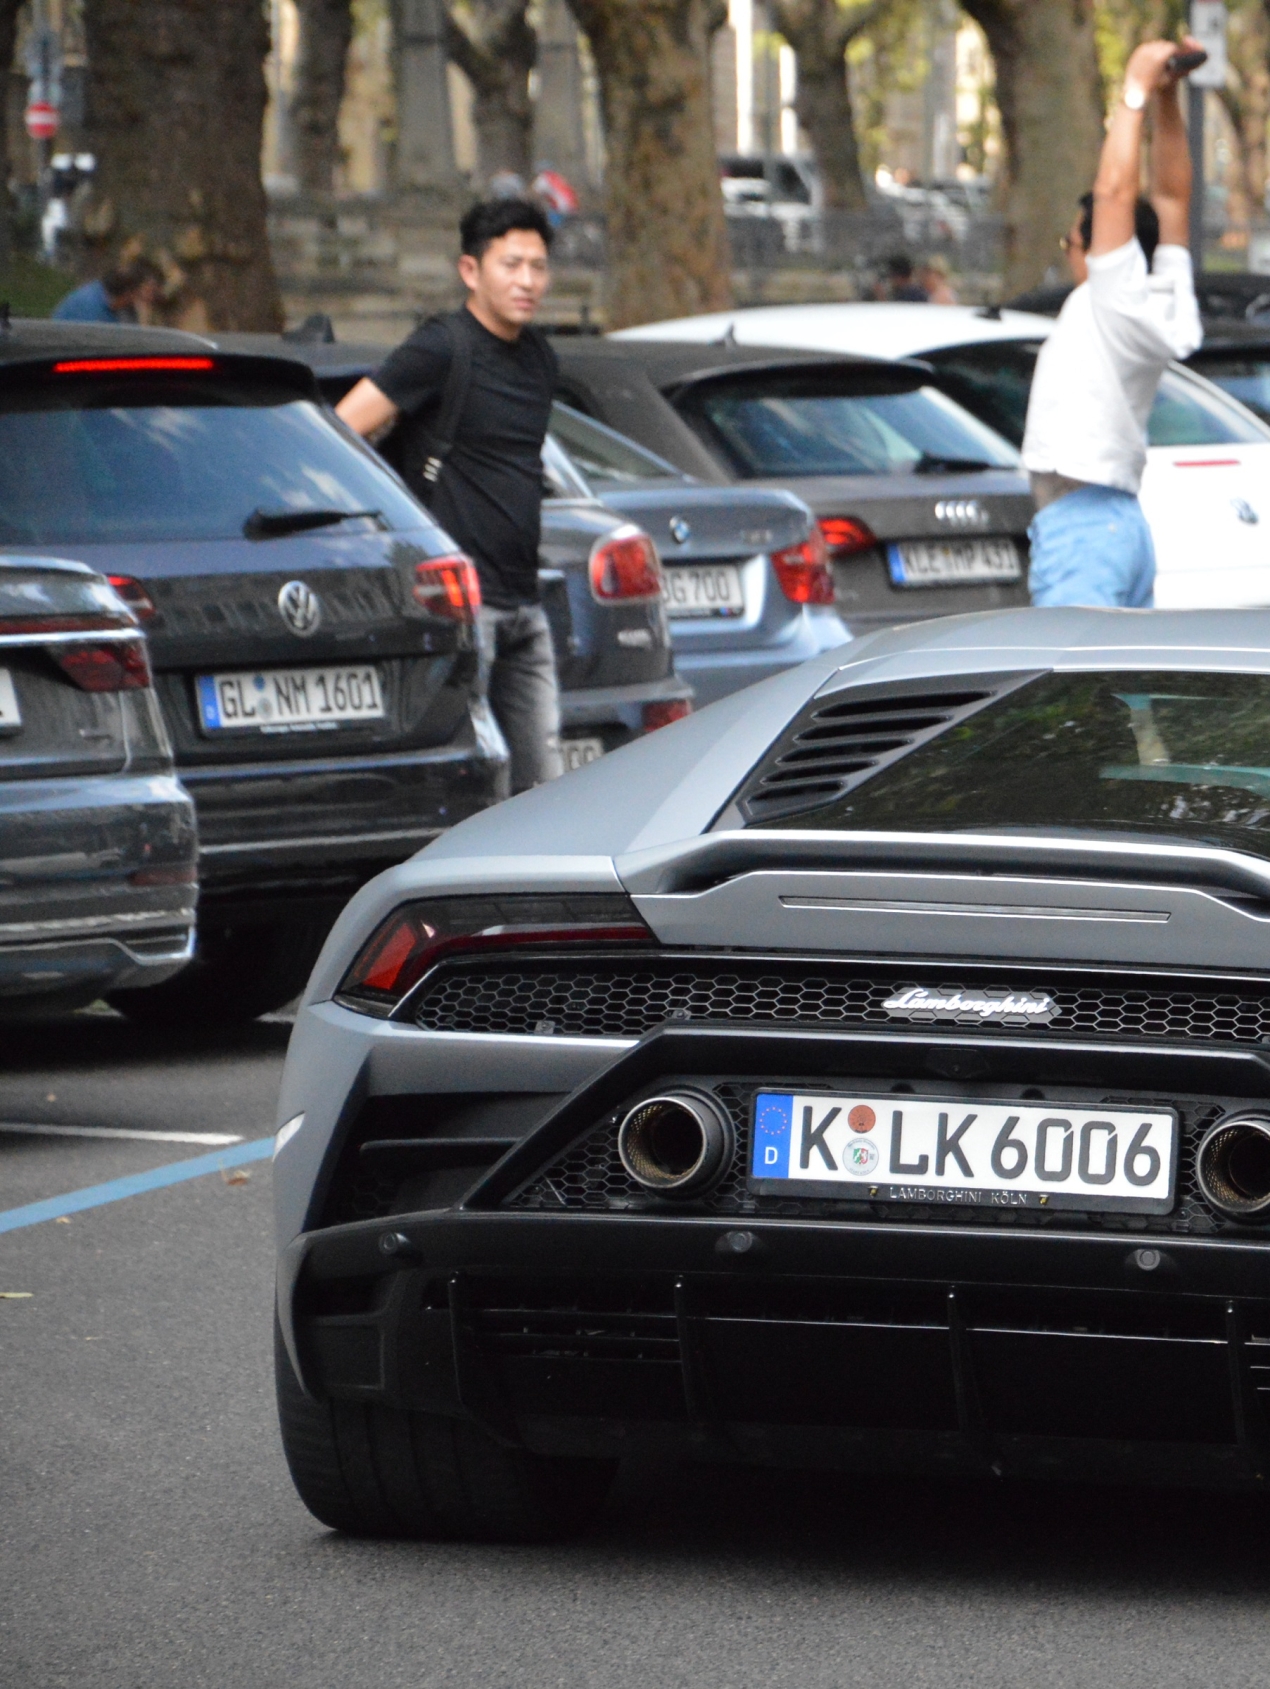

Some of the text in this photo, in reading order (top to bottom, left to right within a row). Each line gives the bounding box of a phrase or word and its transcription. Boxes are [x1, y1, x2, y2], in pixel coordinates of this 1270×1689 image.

[688, 568, 730, 602] 700
[218, 671, 378, 719] GL NM 1601
[883, 988, 1052, 1017] Lamborghini
[764, 1146, 779, 1165] D
[799, 1105, 842, 1171] K
[888, 1110, 978, 1178] LK
[990, 1115, 1161, 1187] 6006
[889, 1186, 1028, 1205] LAMBORGHINI KÖLN
